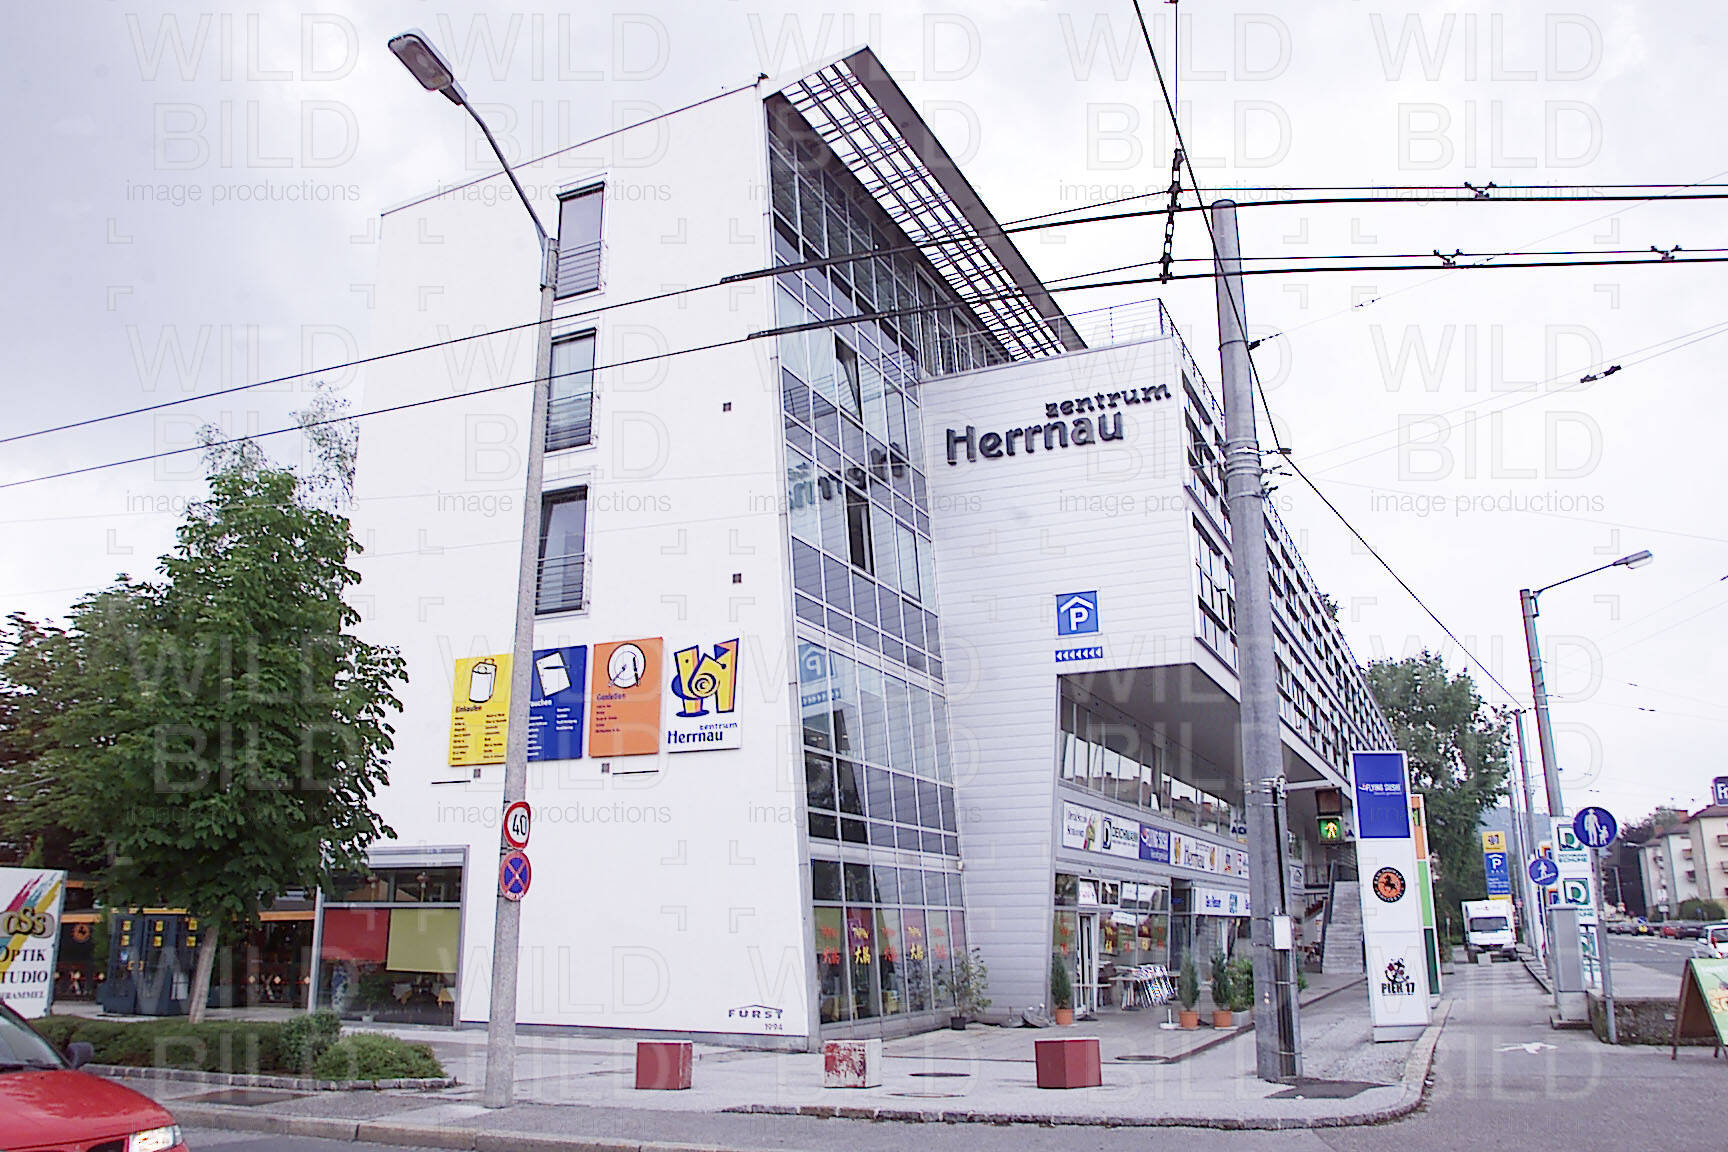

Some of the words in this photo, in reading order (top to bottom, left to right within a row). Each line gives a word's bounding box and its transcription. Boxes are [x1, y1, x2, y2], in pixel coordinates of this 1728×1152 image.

[1046, 384, 1172, 418] zentrum
[946, 411, 1124, 466] Herrnau
[1070, 607, 1089, 631] P
[667, 730, 724, 745] Herrnau
[512, 814, 527, 836] 40
[0, 970, 48, 984] TUDIO
[1381, 983, 1403, 994] PIER
[1405, 983, 1415, 994] 17
